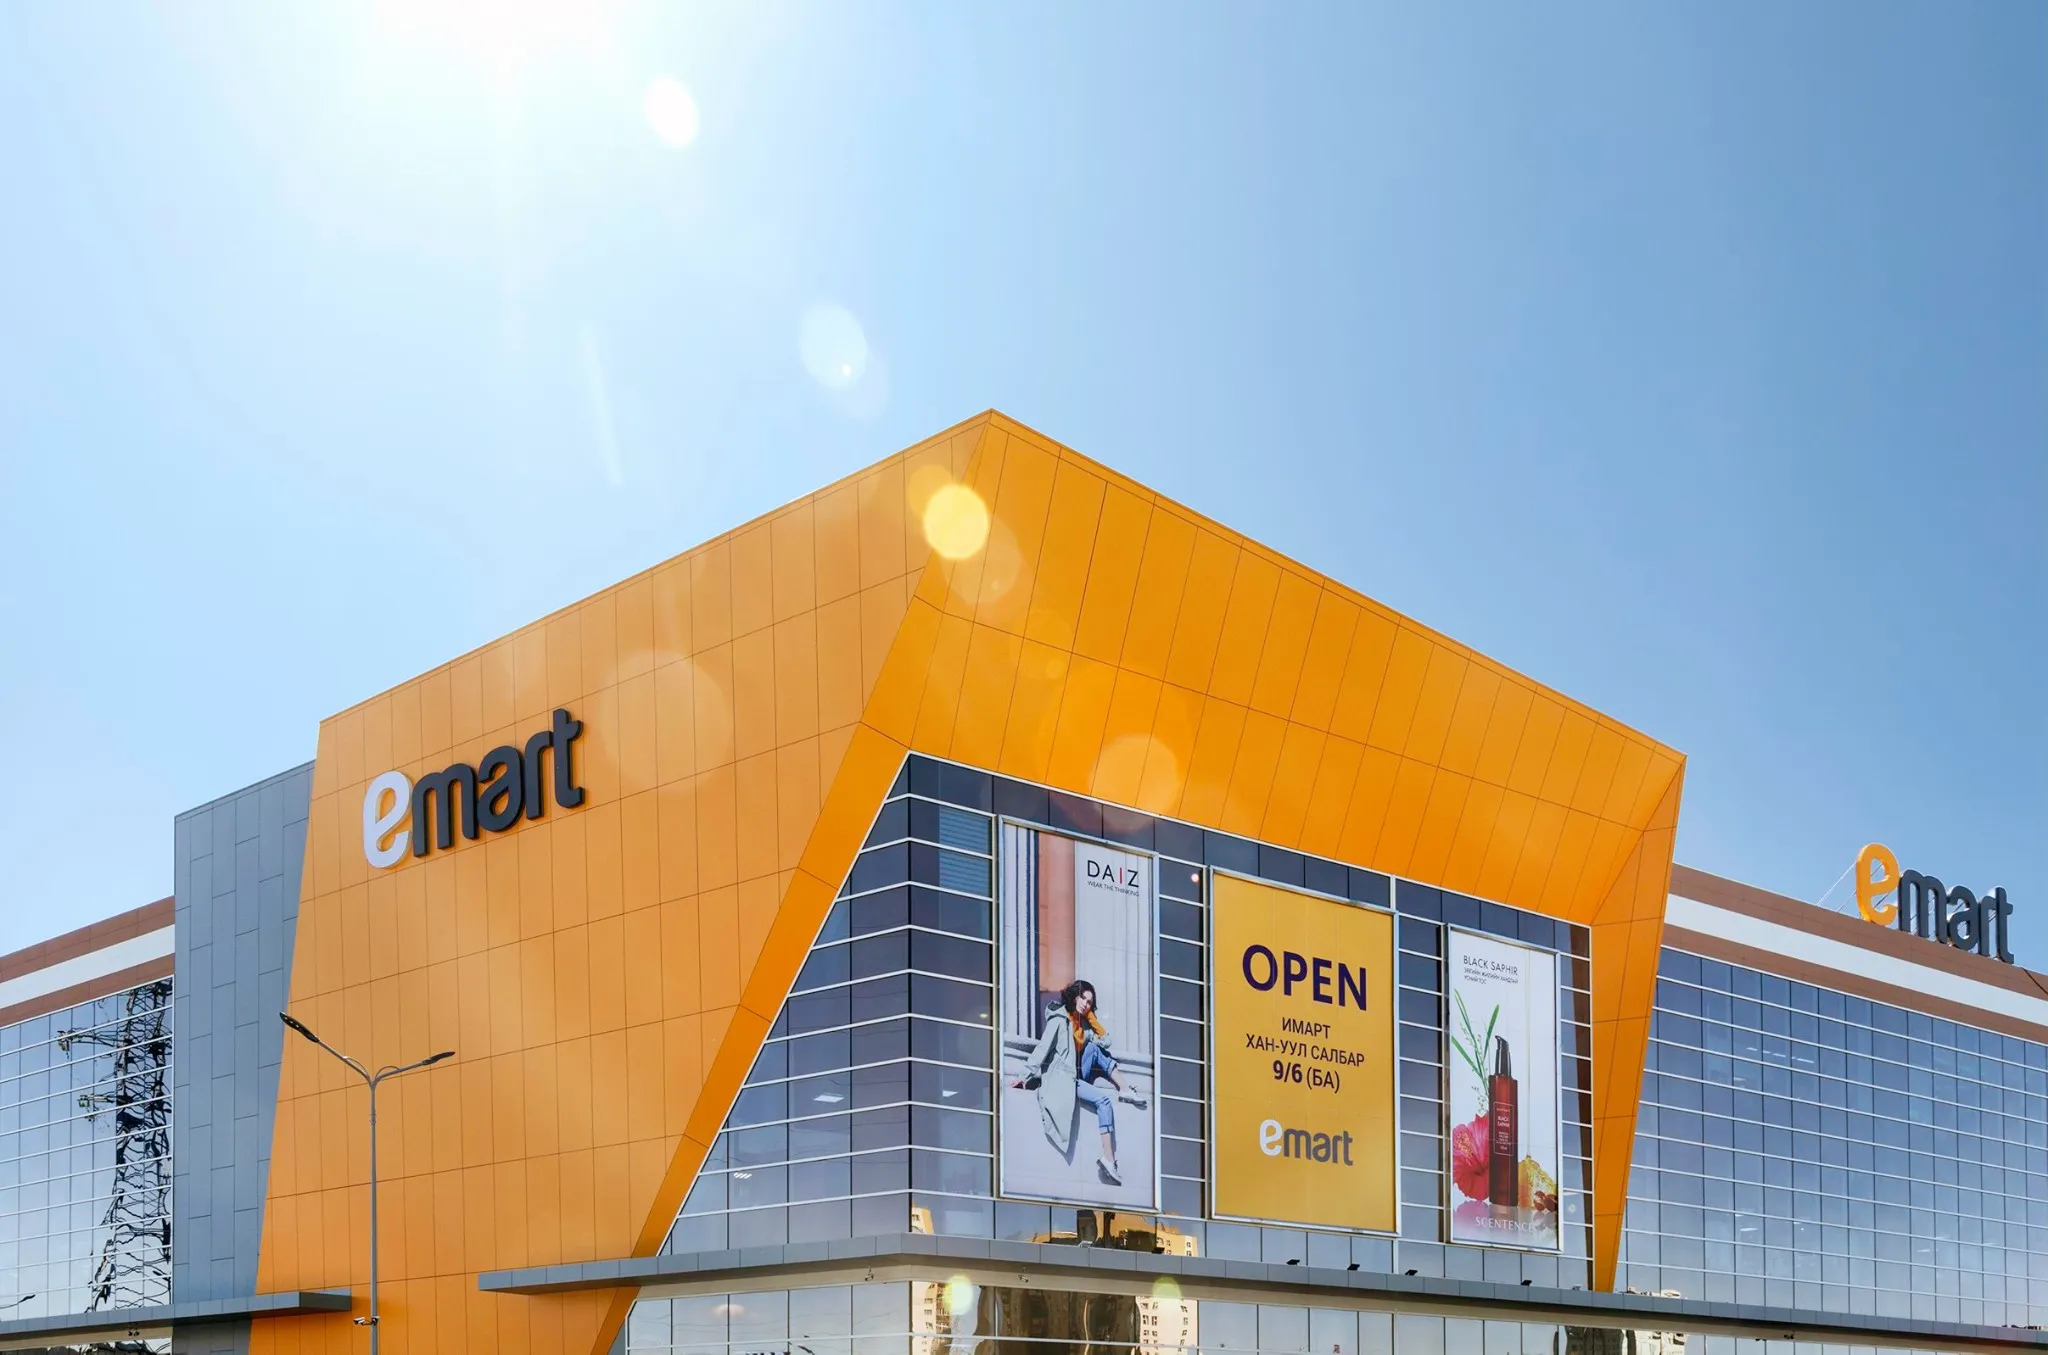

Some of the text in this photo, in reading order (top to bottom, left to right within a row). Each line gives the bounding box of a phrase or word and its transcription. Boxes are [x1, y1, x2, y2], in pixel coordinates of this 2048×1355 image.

[363, 708, 585, 868] emart
[1087, 860, 1139, 888] DAIZ
[1104, 883, 1114, 892] THE
[1855, 842, 2014, 964] emart
[1242, 944, 1367, 1011] OPEN
[1463, 955, 1488, 969] BLACK
[1490, 961, 1518, 976] SAPHIR
[1282, 1016, 1331, 1039] ИМАРТ
[1245, 1033, 1365, 1067] ХАН-УУЛ САЛБАР
[1272, 1060, 1340, 1094] 9/6 (БА)
[1259, 1119, 1354, 1167] emart
[1475, 1216, 1533, 1233] SCENTENCE
